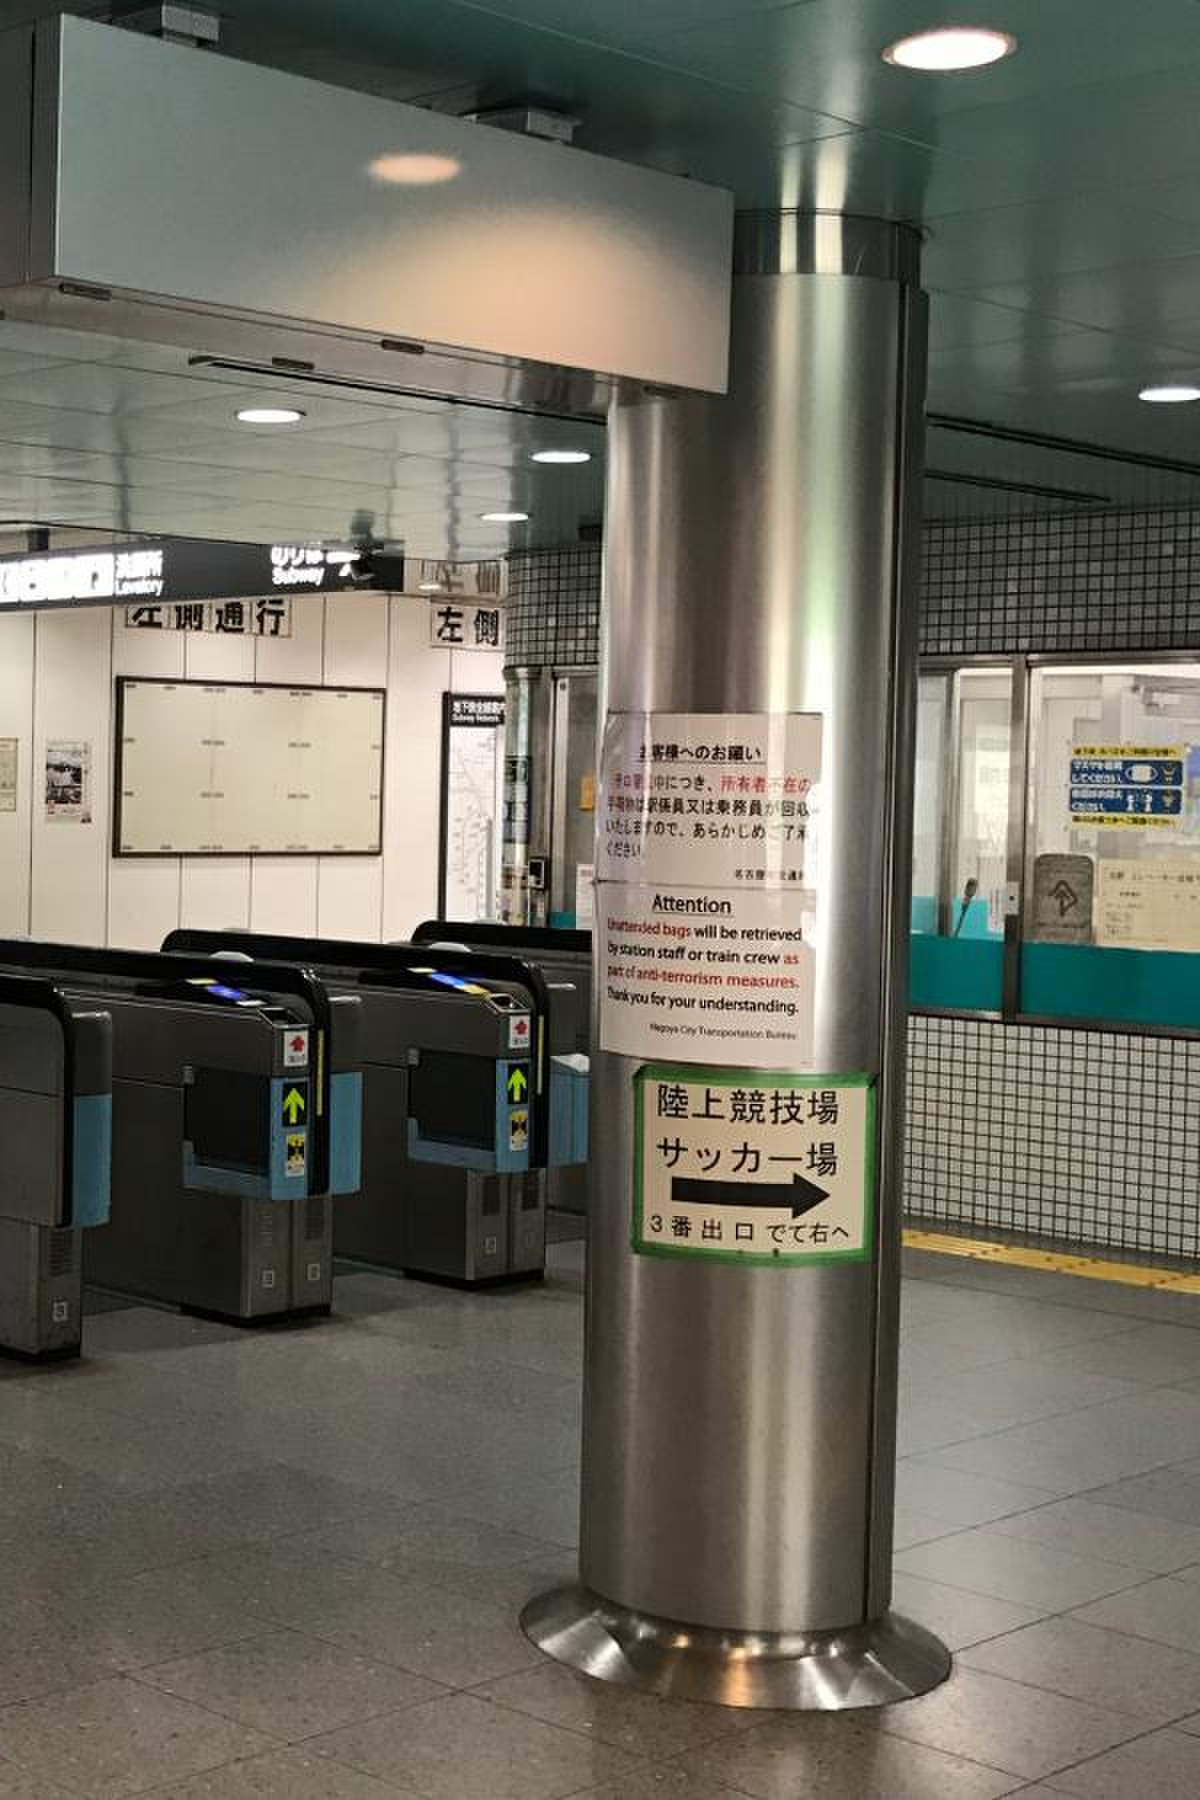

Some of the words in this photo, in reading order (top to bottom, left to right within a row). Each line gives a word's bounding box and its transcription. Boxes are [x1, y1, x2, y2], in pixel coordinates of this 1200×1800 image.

[652, 894, 732, 914] Attention
[663, 922, 690, 941] bags
[694, 925, 718, 939] will
[720, 925, 738, 941] be
[741, 928, 803, 943] retrieved
[607, 941, 618, 957] by
[620, 943, 655, 959] station
[657, 946, 686, 960] staff
[688, 950, 702, 962] or
[706, 949, 739, 964] train
[743, 952, 781, 965] crew
[783, 954, 800, 966] as
[625, 965, 635, 979] of
[637, 968, 723, 986] anti-terrorism
[726, 976, 800, 990] measures.
[607, 985, 628, 1001] Thank
[629, 991, 649, 1006] you
[651, 991, 667, 1006] for
[668, 996, 696, 1010] your
[699, 998, 800, 1016] understanding.
[657, 1083, 839, 1126] 陸上競技場
[657, 1137, 838, 1177] サッカー場
[650, 1215, 849, 1244] 3番出口でて右へ
